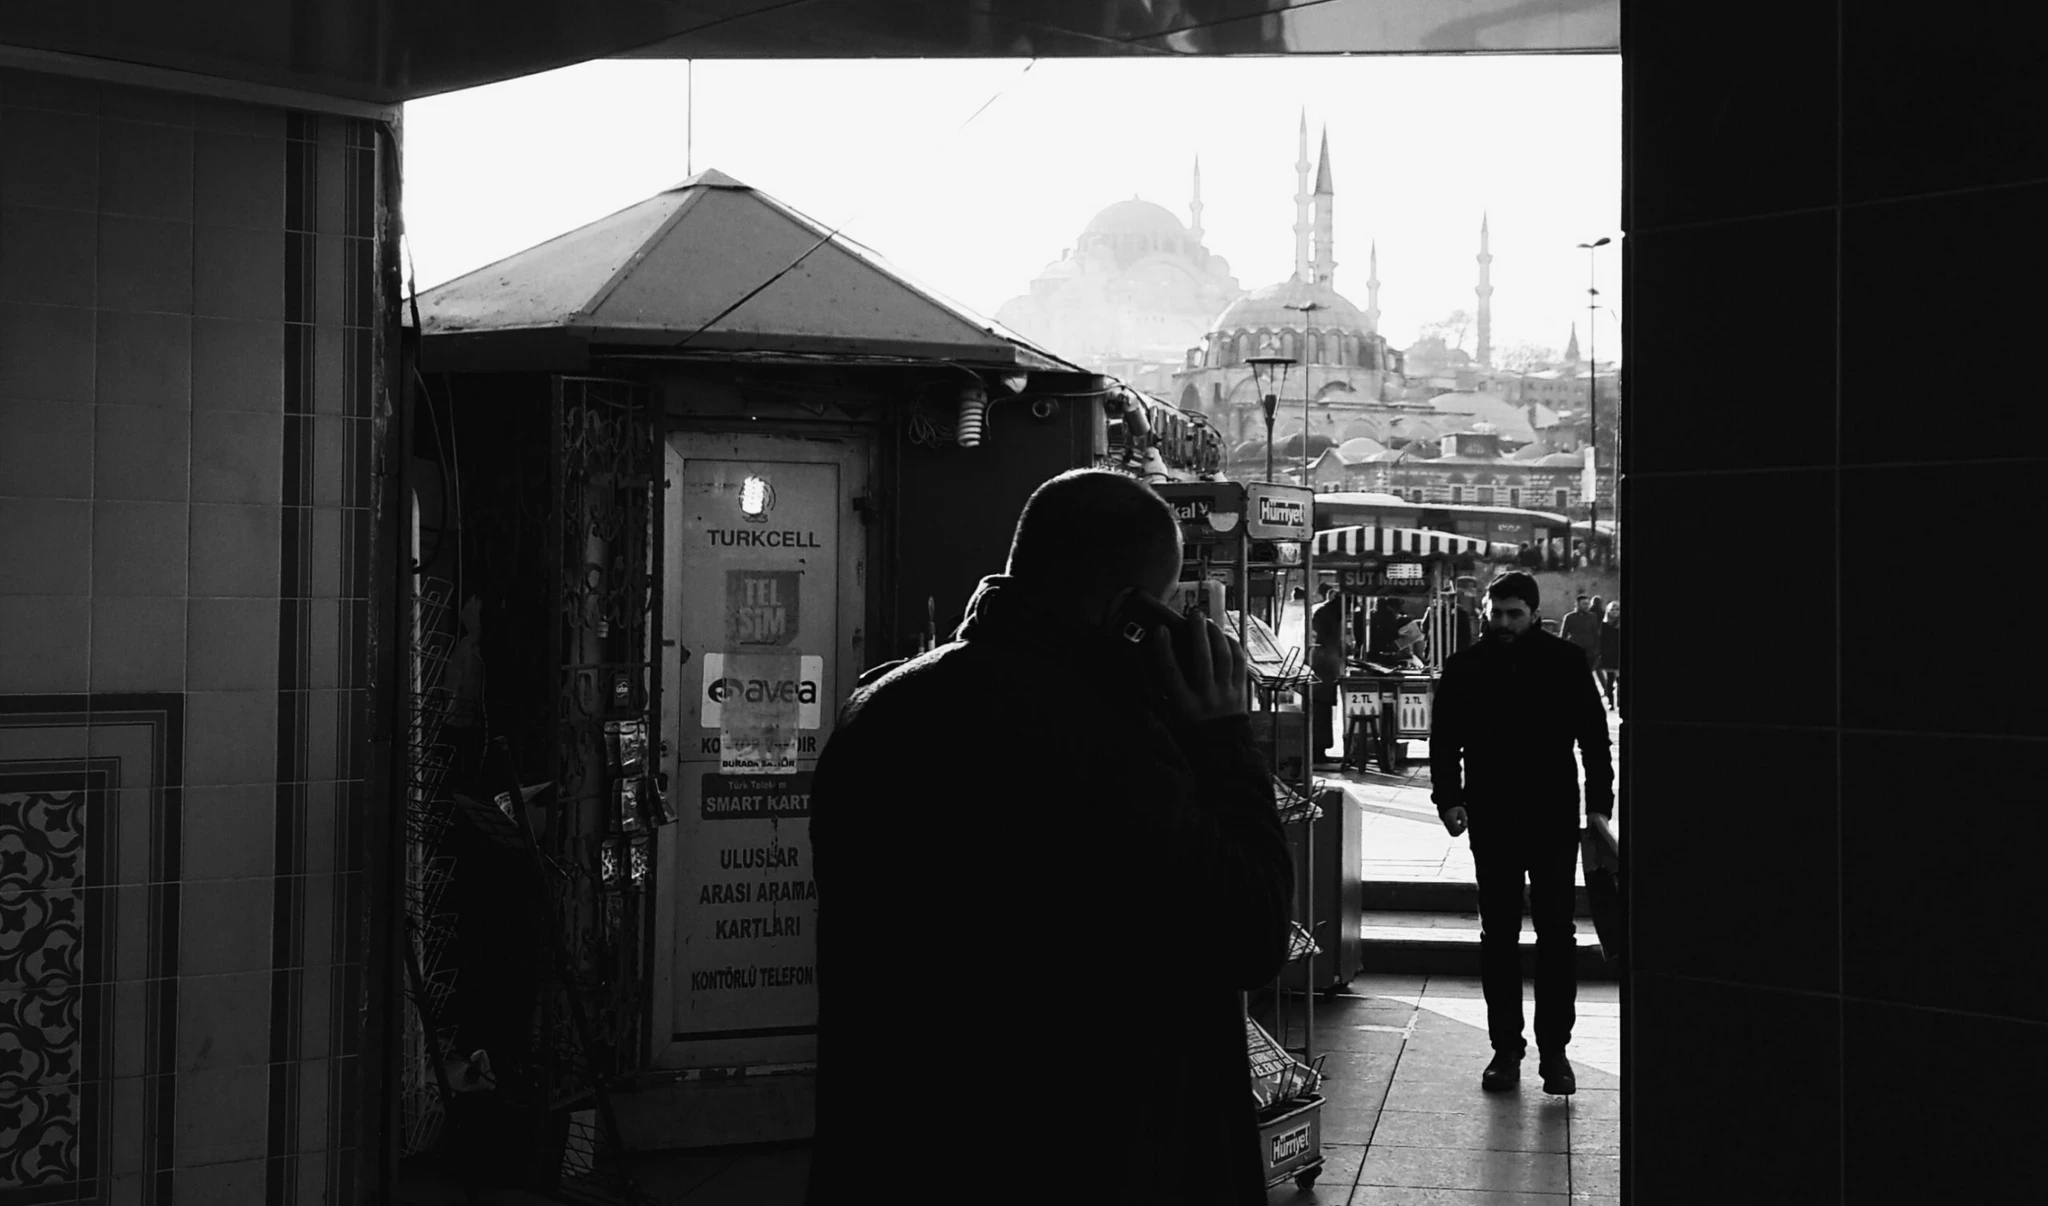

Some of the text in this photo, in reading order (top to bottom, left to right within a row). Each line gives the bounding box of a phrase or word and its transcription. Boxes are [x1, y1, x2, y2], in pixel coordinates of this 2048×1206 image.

[1170, 502, 1196, 519] kal
[707, 529, 822, 548] TURKCELL
[743, 578, 782, 607] TEL
[745, 679, 817, 704] avea
[750, 780, 787, 790] Telekm
[706, 794, 811, 813] SMART KART
[720, 847, 799, 869] ULUSLAR
[700, 880, 817, 905] ARASI ARAMA
[715, 916, 801, 939] KARTLARI
[691, 965, 813, 991] KONTÖRLÜ TELEFON
